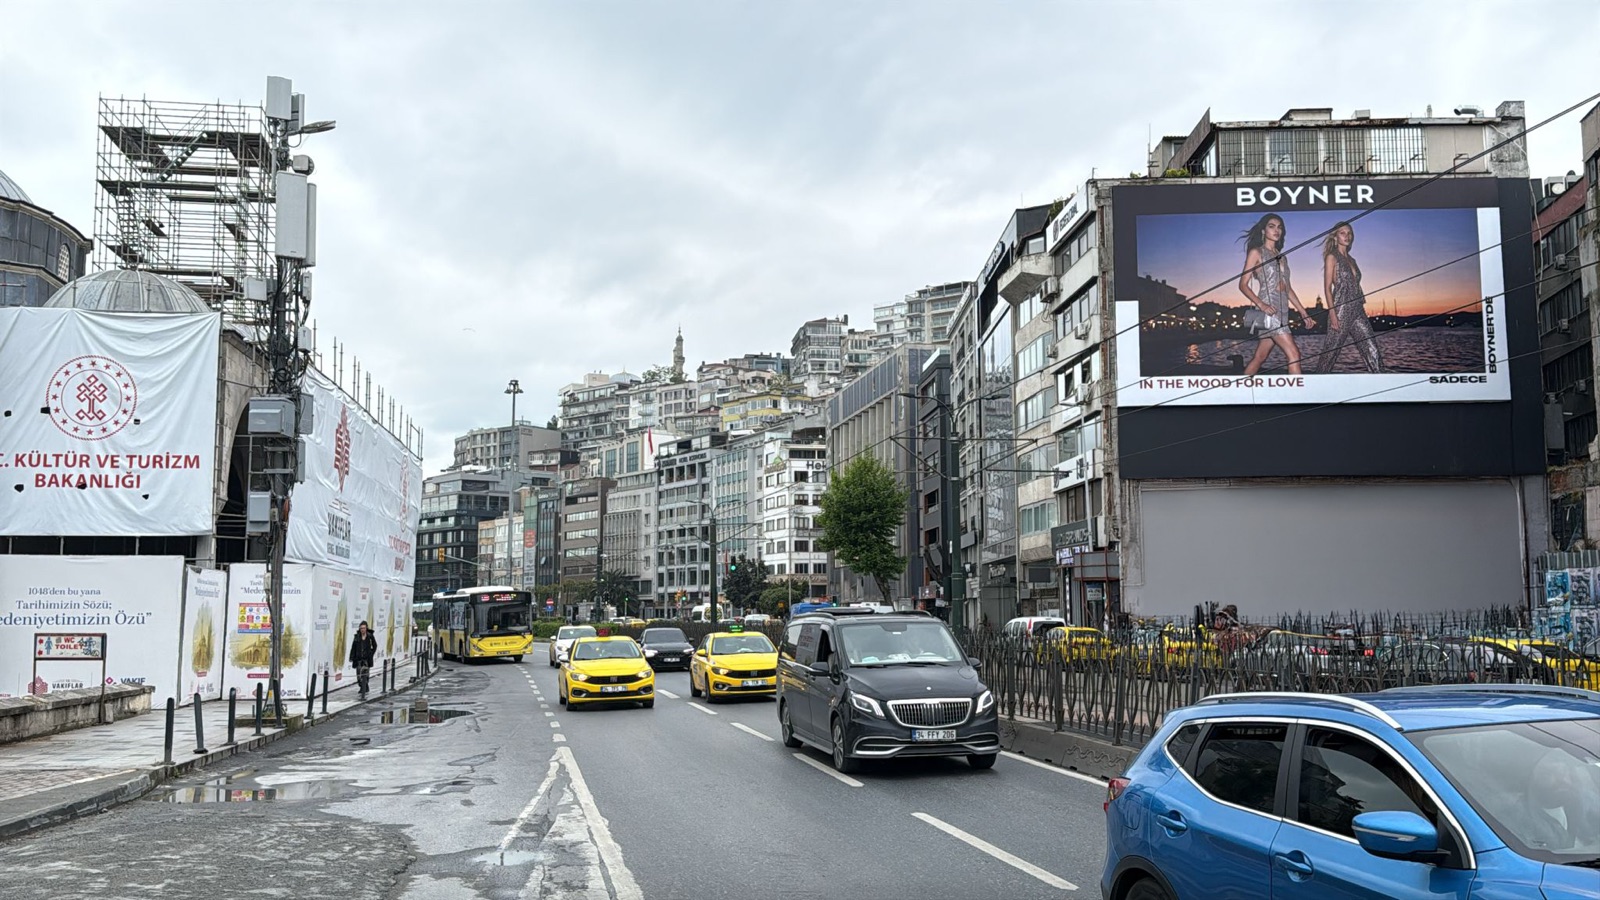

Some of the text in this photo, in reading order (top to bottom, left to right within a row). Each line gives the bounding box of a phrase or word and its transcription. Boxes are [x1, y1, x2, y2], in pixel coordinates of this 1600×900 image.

[1236, 184, 1375, 207] BOYNER
[1484, 295, 1498, 375] BOYNER'DE
[1139, 376, 1305, 390] IN THE MOOD FOR LOVE
[1429, 374, 1488, 384] SADECE
[14, 450, 91, 468] KÜLTÜR
[96, 454, 120, 469] VE
[126, 452, 200, 469] TURİZM
[34, 471, 141, 489] BAKANLIĞI
[67, 587, 79, 596] bu
[80, 590, 101, 598] yana
[15, 599, 112, 611] Tarihimizin Sözü;
[52, 682, 84, 690] VAKIFLAR
[916, 730, 955, 739] 34 FFY 206
